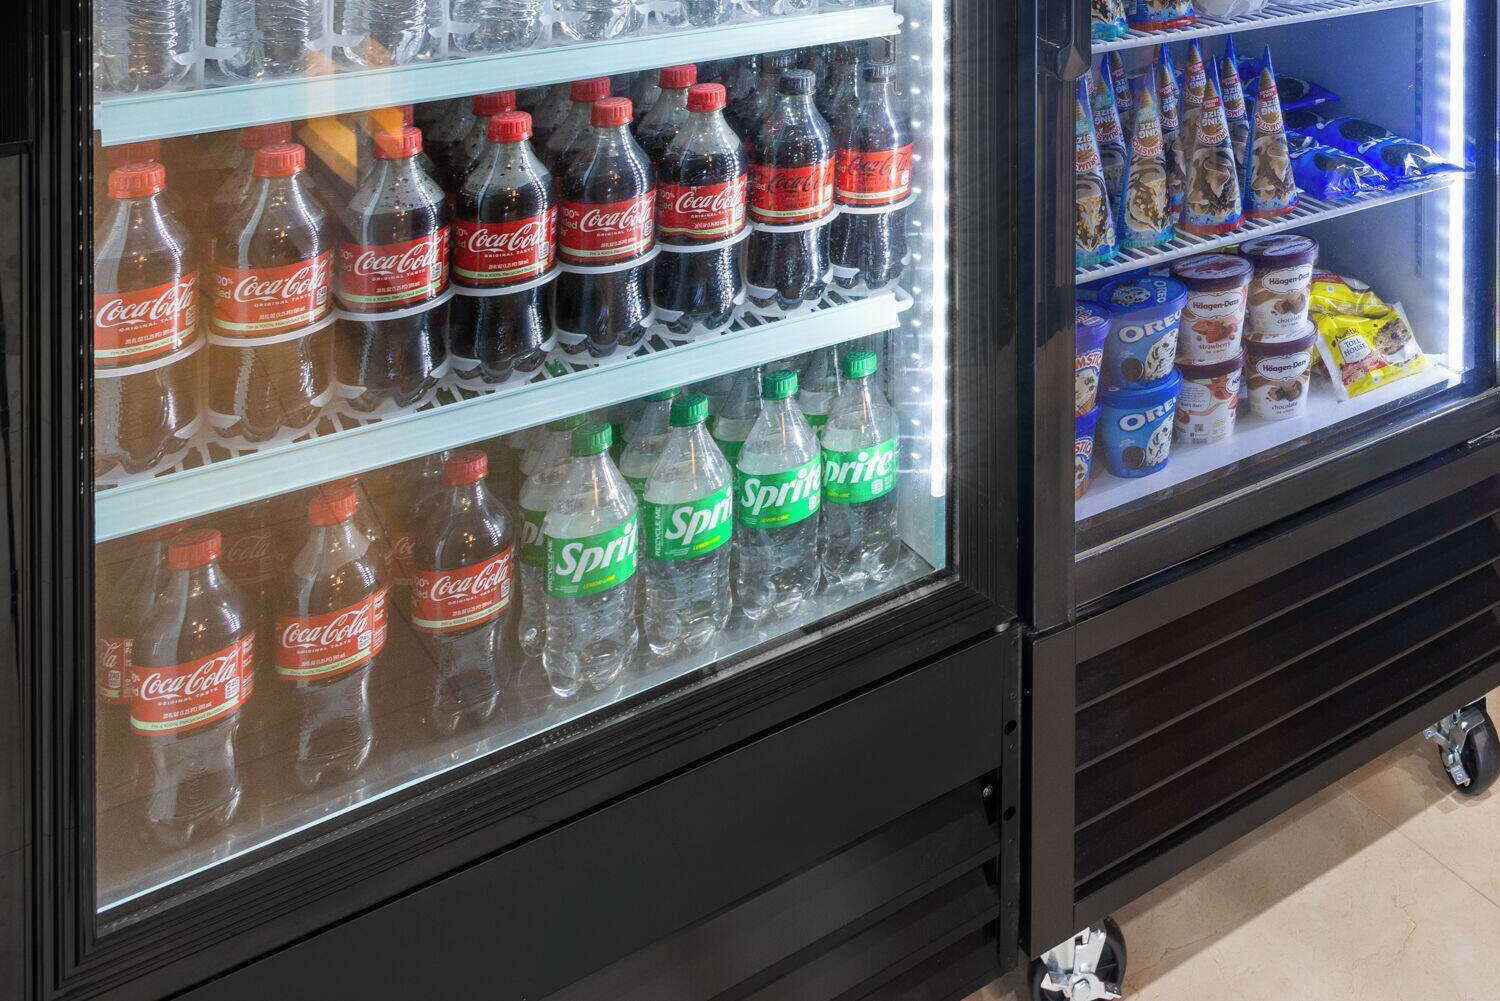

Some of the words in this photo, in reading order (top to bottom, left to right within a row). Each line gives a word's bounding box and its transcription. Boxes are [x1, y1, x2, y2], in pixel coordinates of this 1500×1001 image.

[580, 193, 652, 233] Coca-Cola
[675, 180, 743, 214] Coca-Cola
[468, 216, 548, 253] Coca-Cola
[355, 235, 440, 277] Coca-Cola
[234, 259, 325, 303] Coca-Cola
[1154, 280, 1167, 303] OREO
[96, 280, 194, 328] Coca-Cola
[1119, 309, 1182, 343] OREO
[1344, 343, 1368, 357] HOUSE
[1119, 396, 1177, 432] ORE
[431, 552, 510, 602] Coca-Cola
[282, 601, 372, 649] Coca-Cola
[141, 648, 239, 701] Coca-Cola
